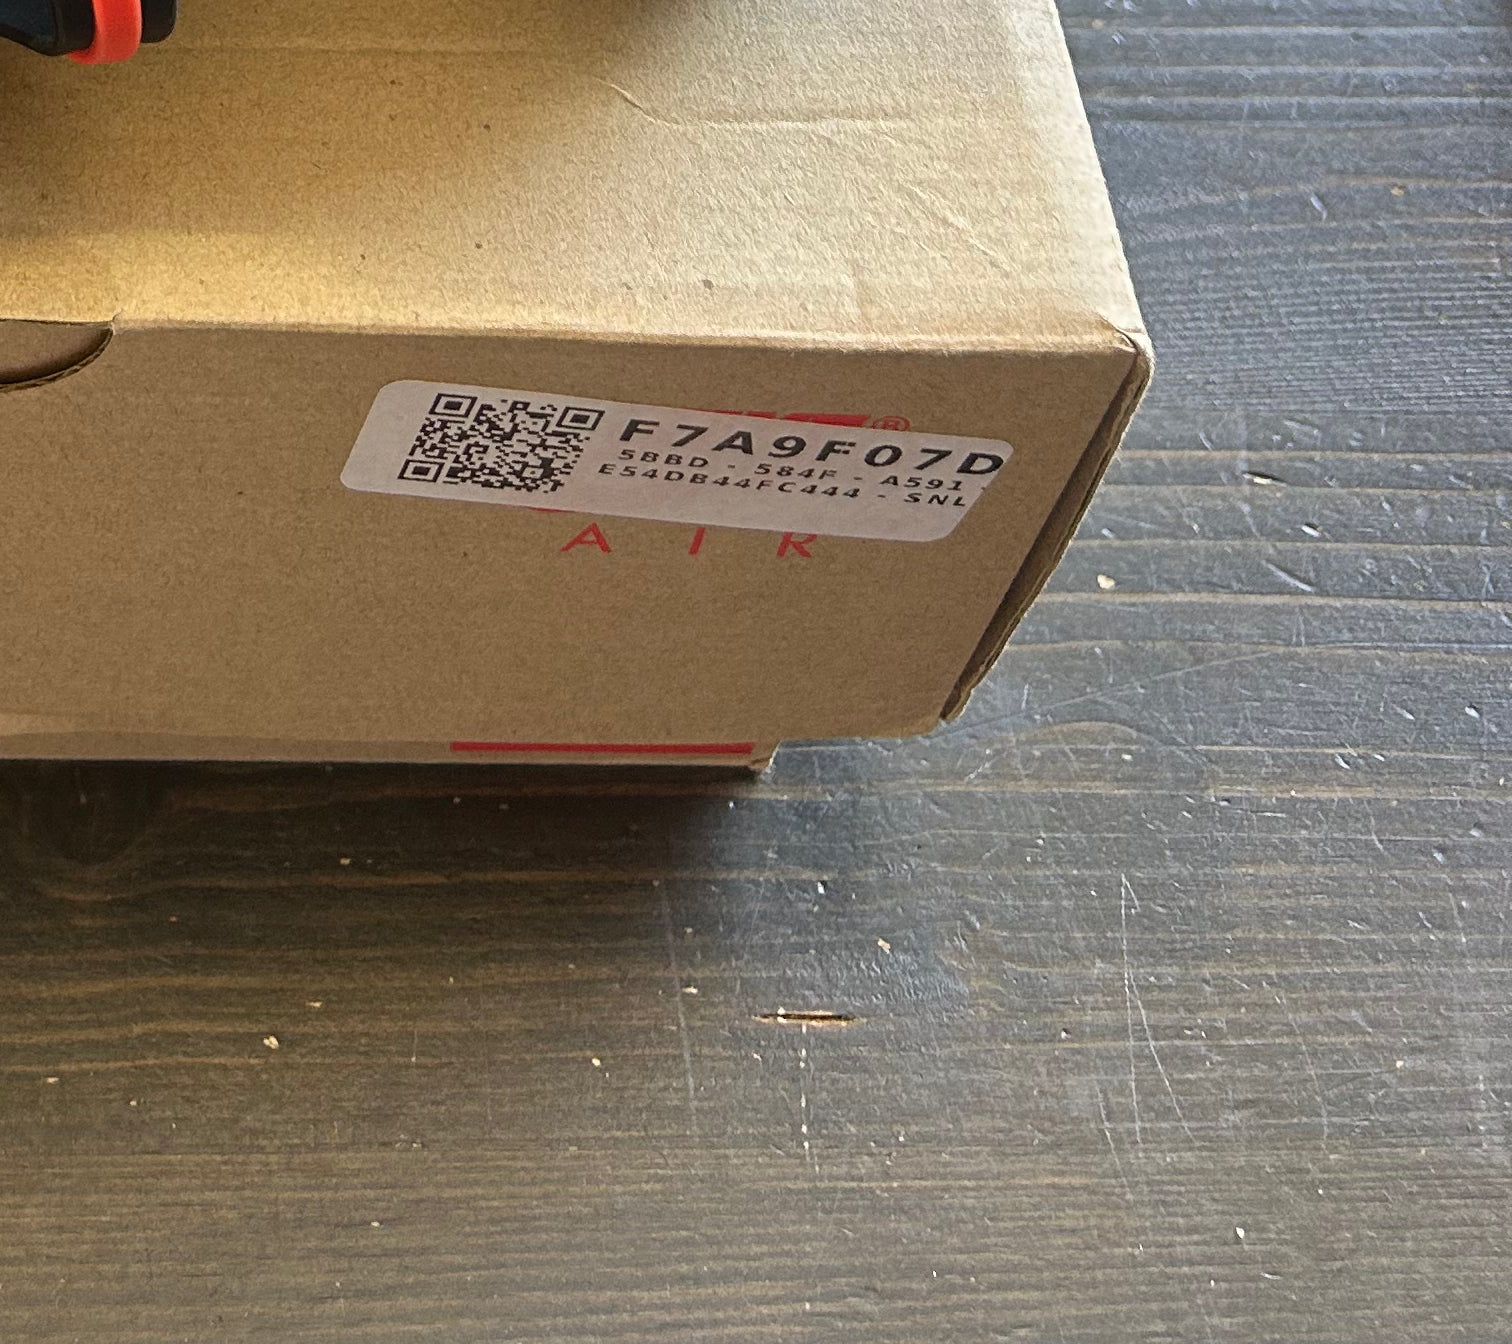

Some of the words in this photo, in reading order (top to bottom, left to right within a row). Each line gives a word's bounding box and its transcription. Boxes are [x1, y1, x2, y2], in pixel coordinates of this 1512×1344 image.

[619, 419, 1004, 475] F7A9F07D
[598, 463, 860, 499] E54DB44FC444
[903, 492, 967, 507] SNL
[753, 463, 838, 481] 584F
[879, 475, 964, 492] A591
